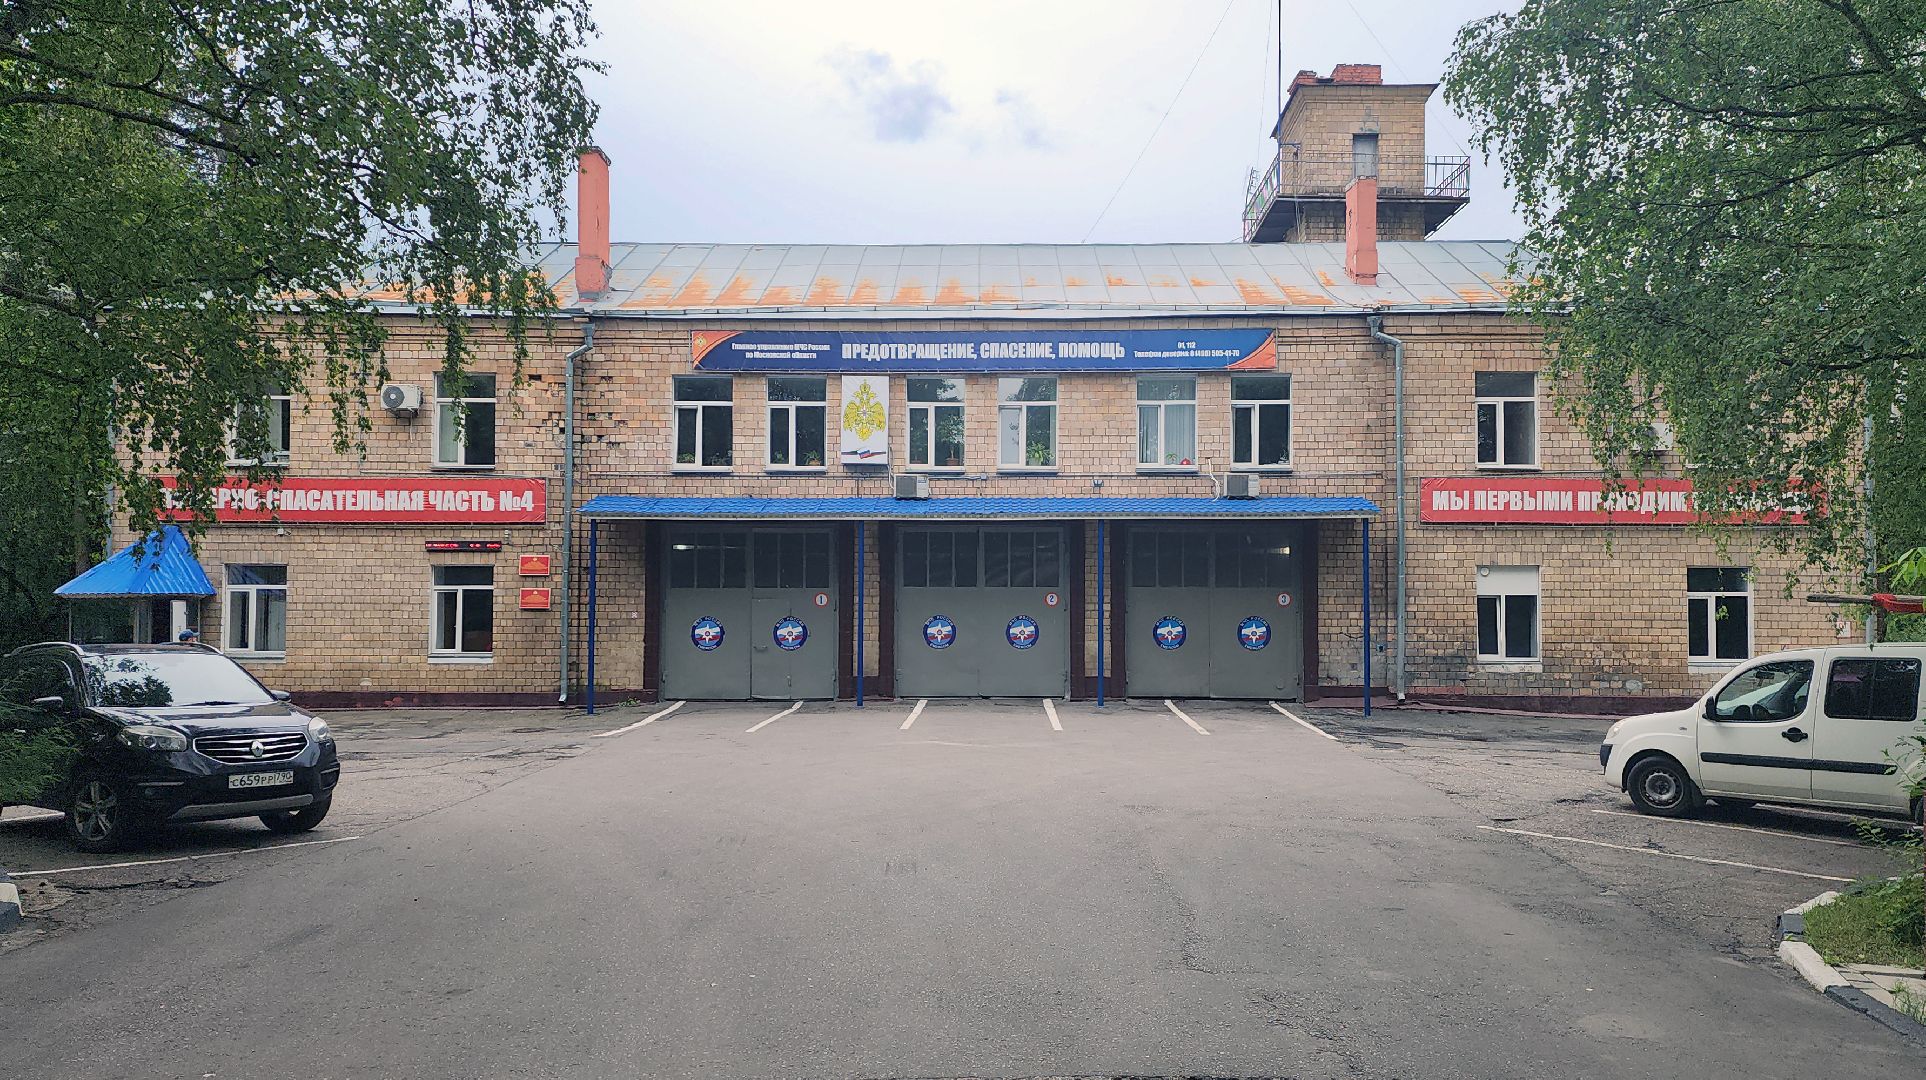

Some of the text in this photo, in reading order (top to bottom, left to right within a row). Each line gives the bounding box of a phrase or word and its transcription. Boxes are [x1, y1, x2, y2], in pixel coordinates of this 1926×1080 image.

[841, 342, 1125, 360] ПРЕДОТВРАЩЕНИЕ, СПАСЕНИЕ, ПОМОЩЬ
[428, 490, 495, 512] ЧАСТЬ
[499, 490, 534, 512] №4
[1432, 490, 1469, 511] МЫ
[1474, 490, 1573, 511] ПЕРВЫМИ
